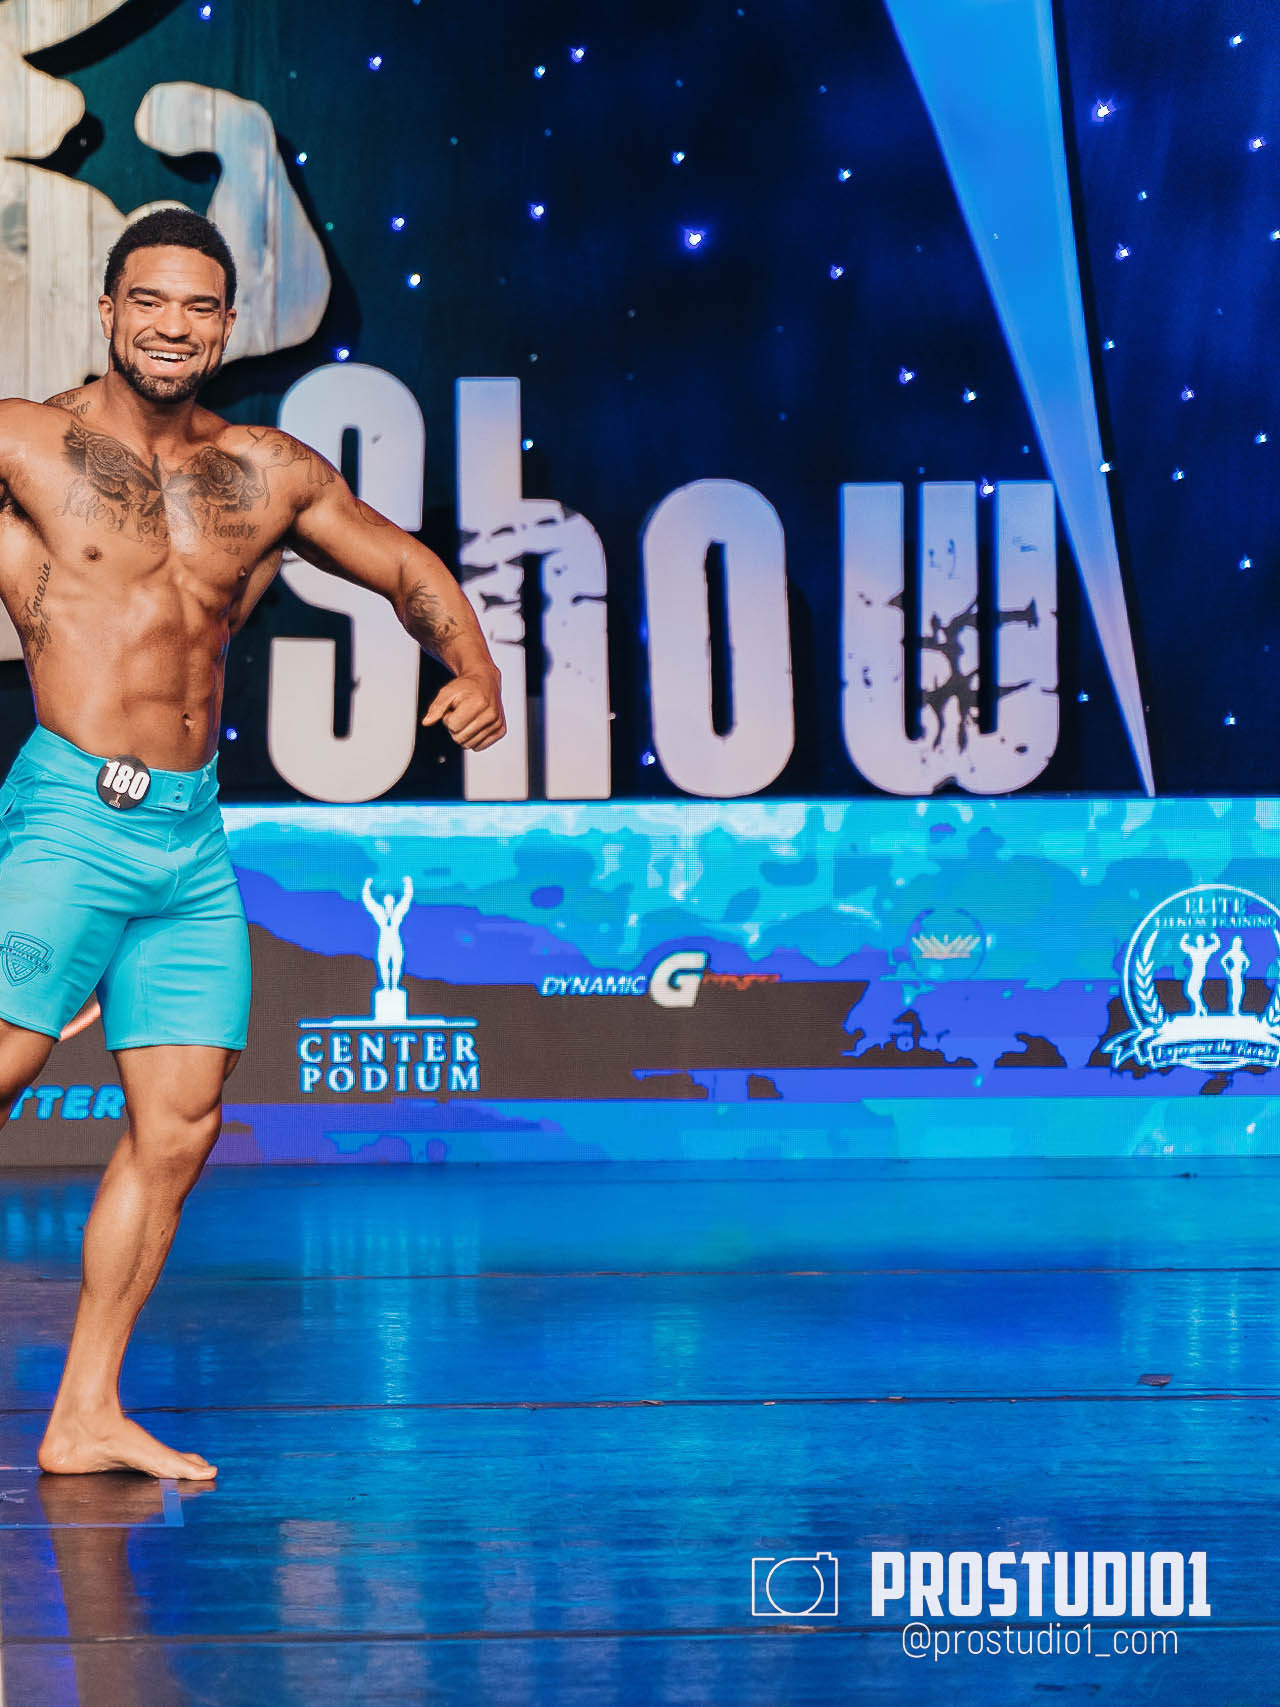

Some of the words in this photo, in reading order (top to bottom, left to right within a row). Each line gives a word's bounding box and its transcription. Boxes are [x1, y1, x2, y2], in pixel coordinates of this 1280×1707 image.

[267, 361, 1060, 804] Show
[102, 760, 151, 801] 180
[540, 973, 648, 997] DYNAMIC
[297, 1032, 479, 1064] CENTER
[300, 1063, 480, 1093] PODIUM
